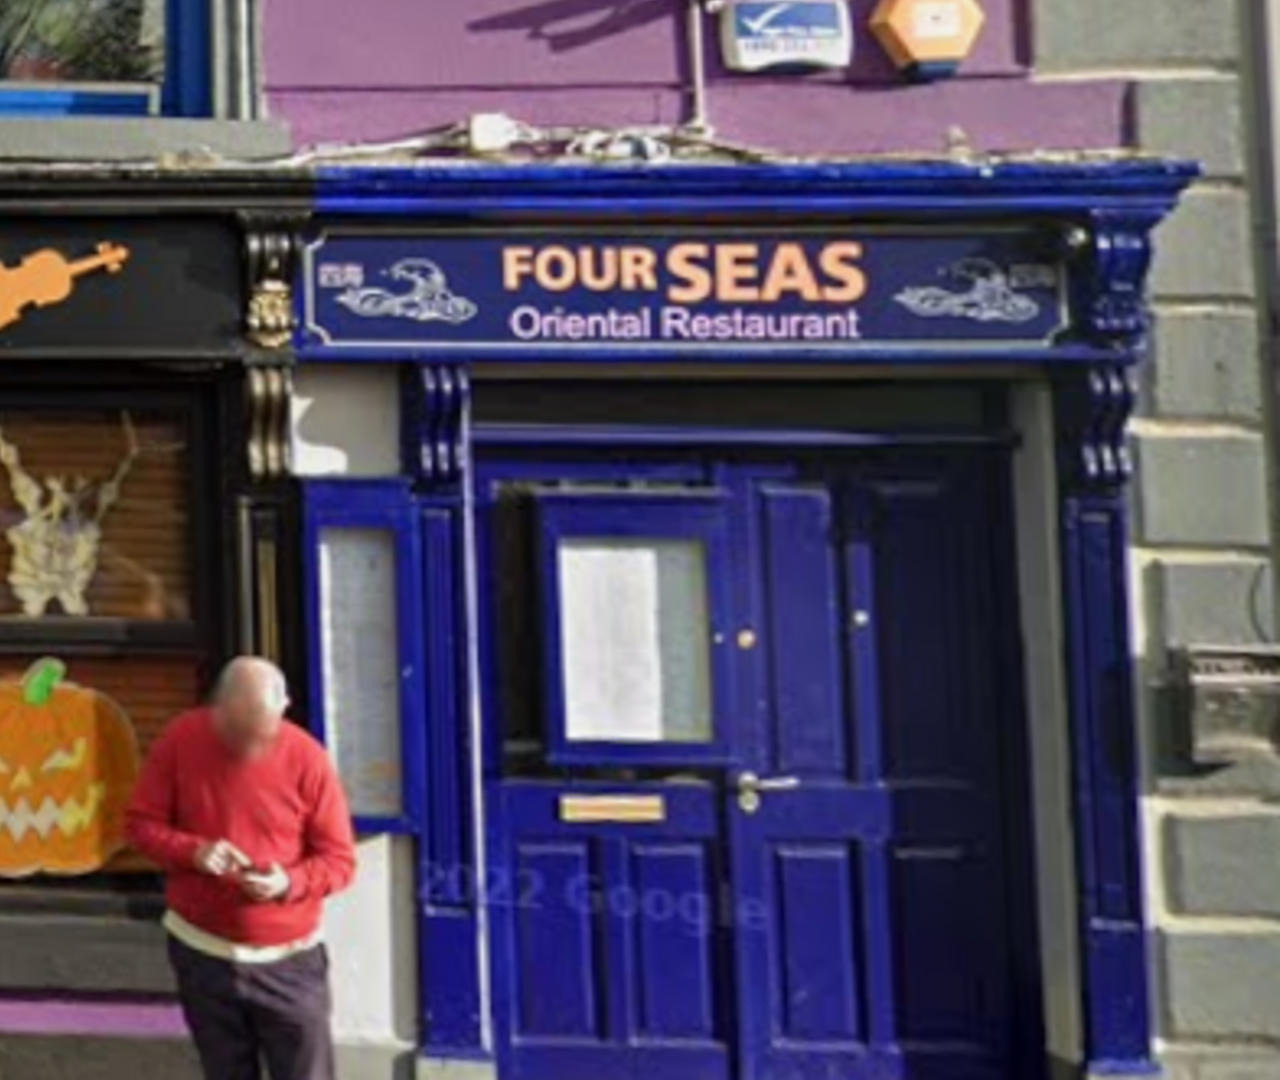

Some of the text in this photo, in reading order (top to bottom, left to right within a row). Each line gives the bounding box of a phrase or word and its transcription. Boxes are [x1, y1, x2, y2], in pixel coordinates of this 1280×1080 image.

[502, 241, 868, 304] FOUR SEAS
[510, 306, 861, 339] Oriental Restaurant
